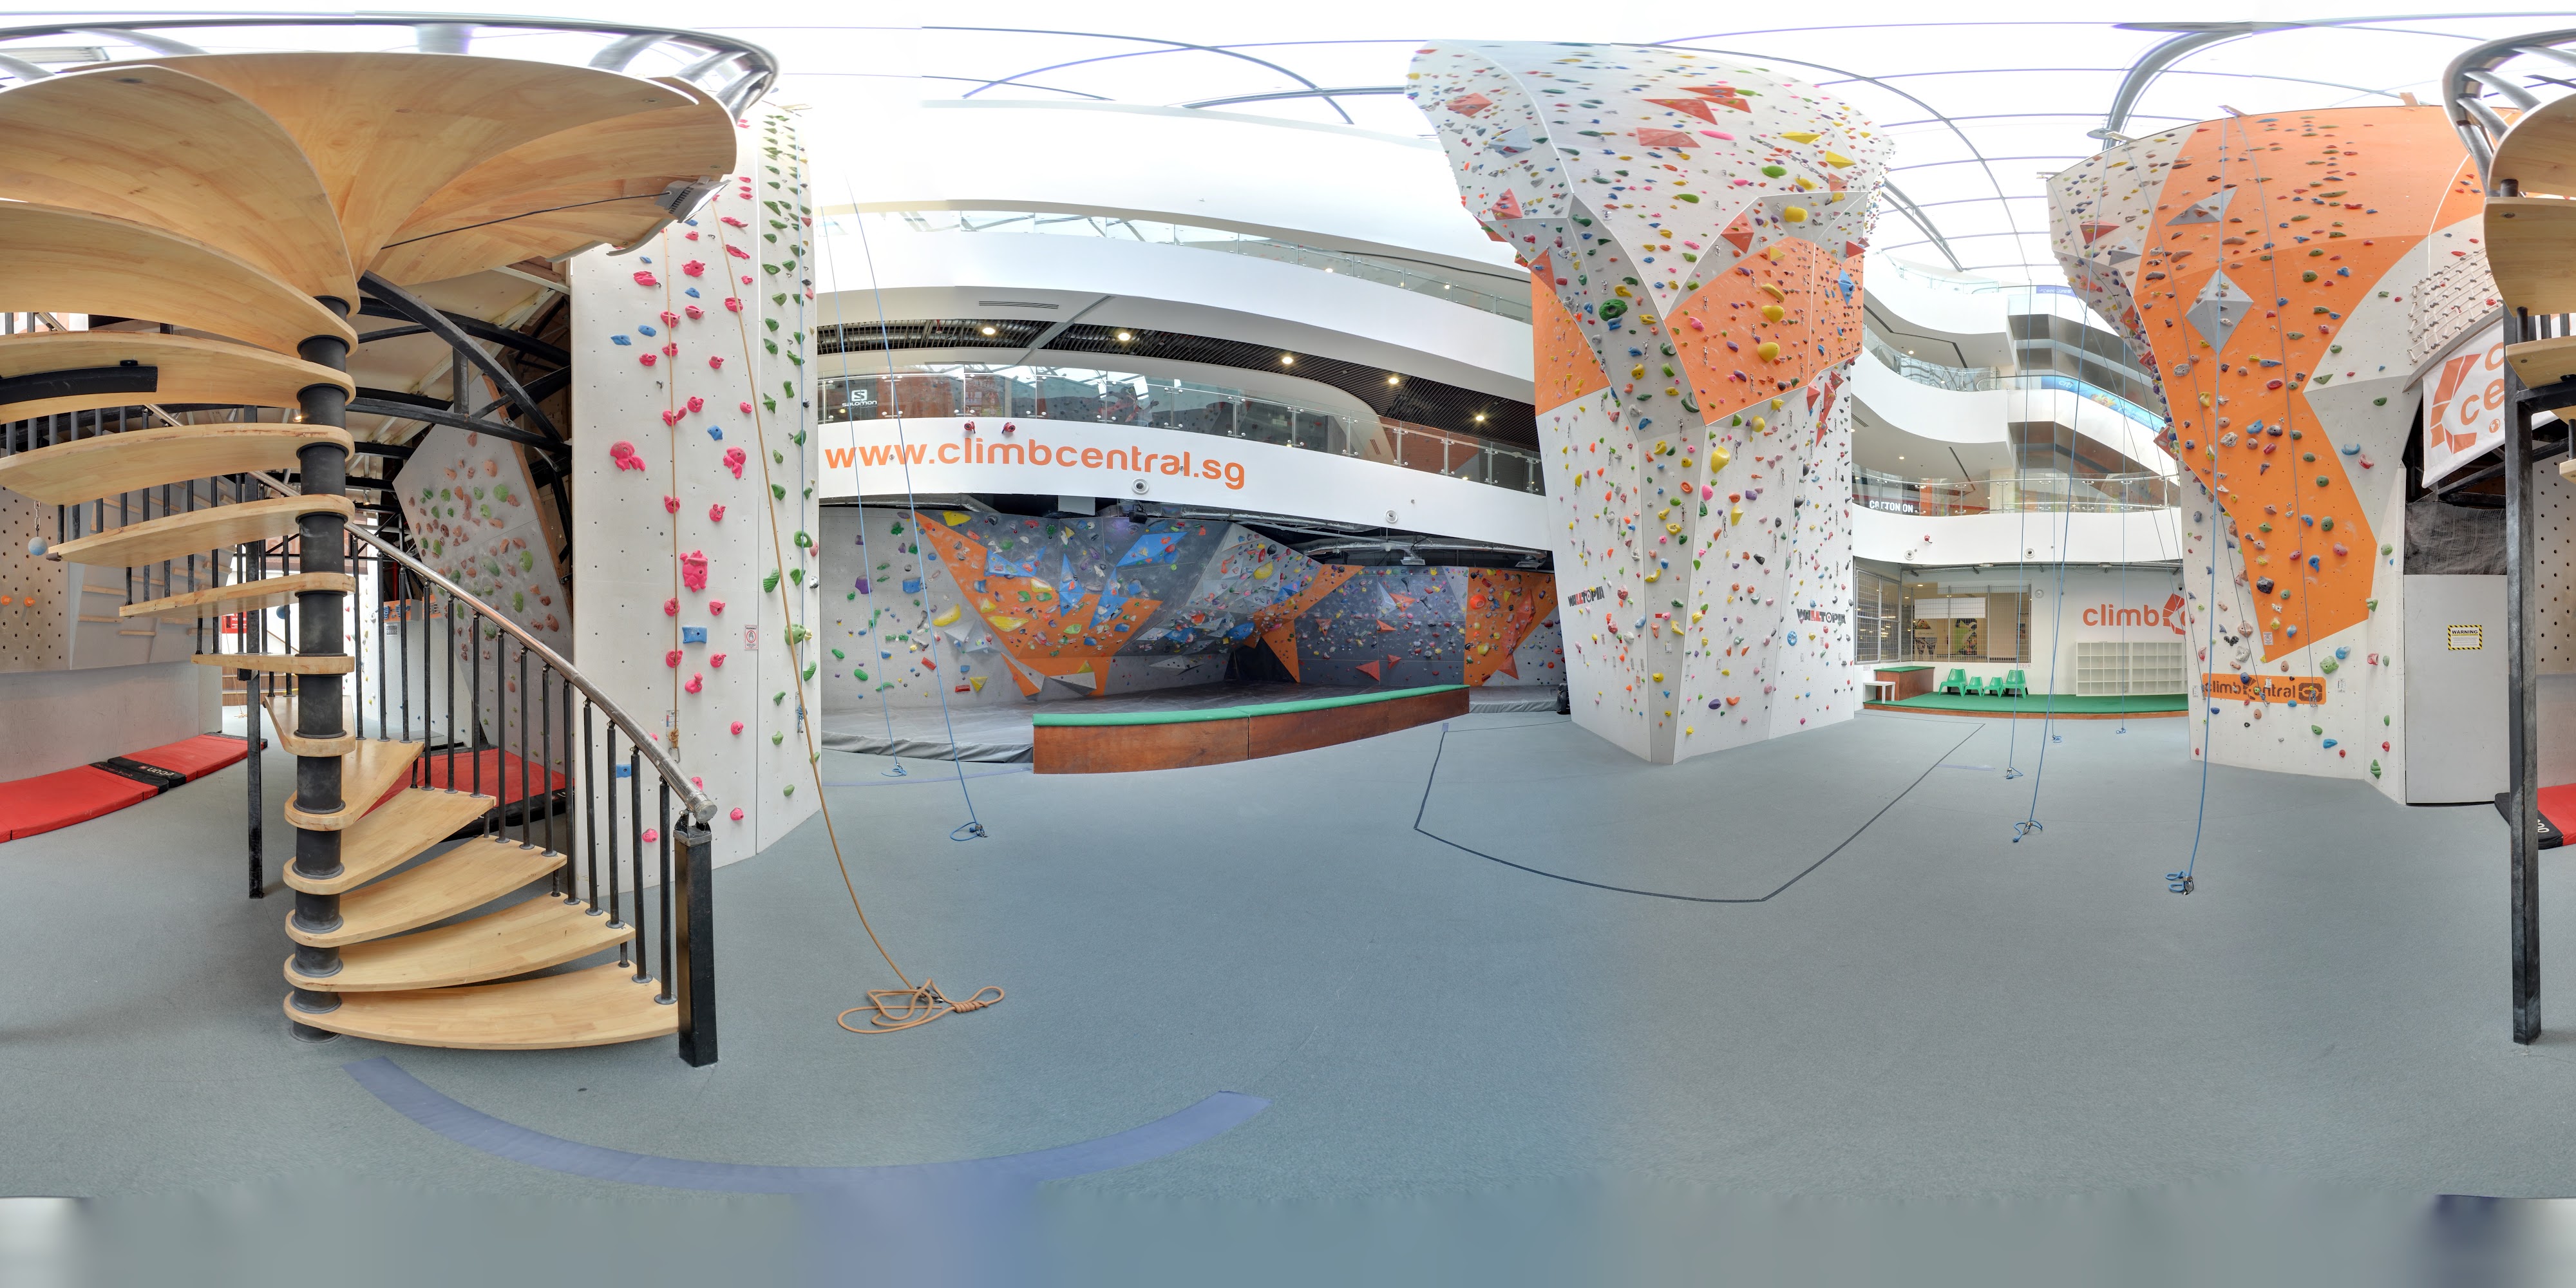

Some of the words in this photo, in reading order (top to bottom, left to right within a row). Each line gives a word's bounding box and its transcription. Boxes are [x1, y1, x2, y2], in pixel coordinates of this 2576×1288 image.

[825, 439, 1245, 490] www.climbcentral.sg
[1902, 504, 1913, 513] ON
[1567, 585, 1605, 607] WALLTOPIA
[2083, 604, 2159, 627] climb
